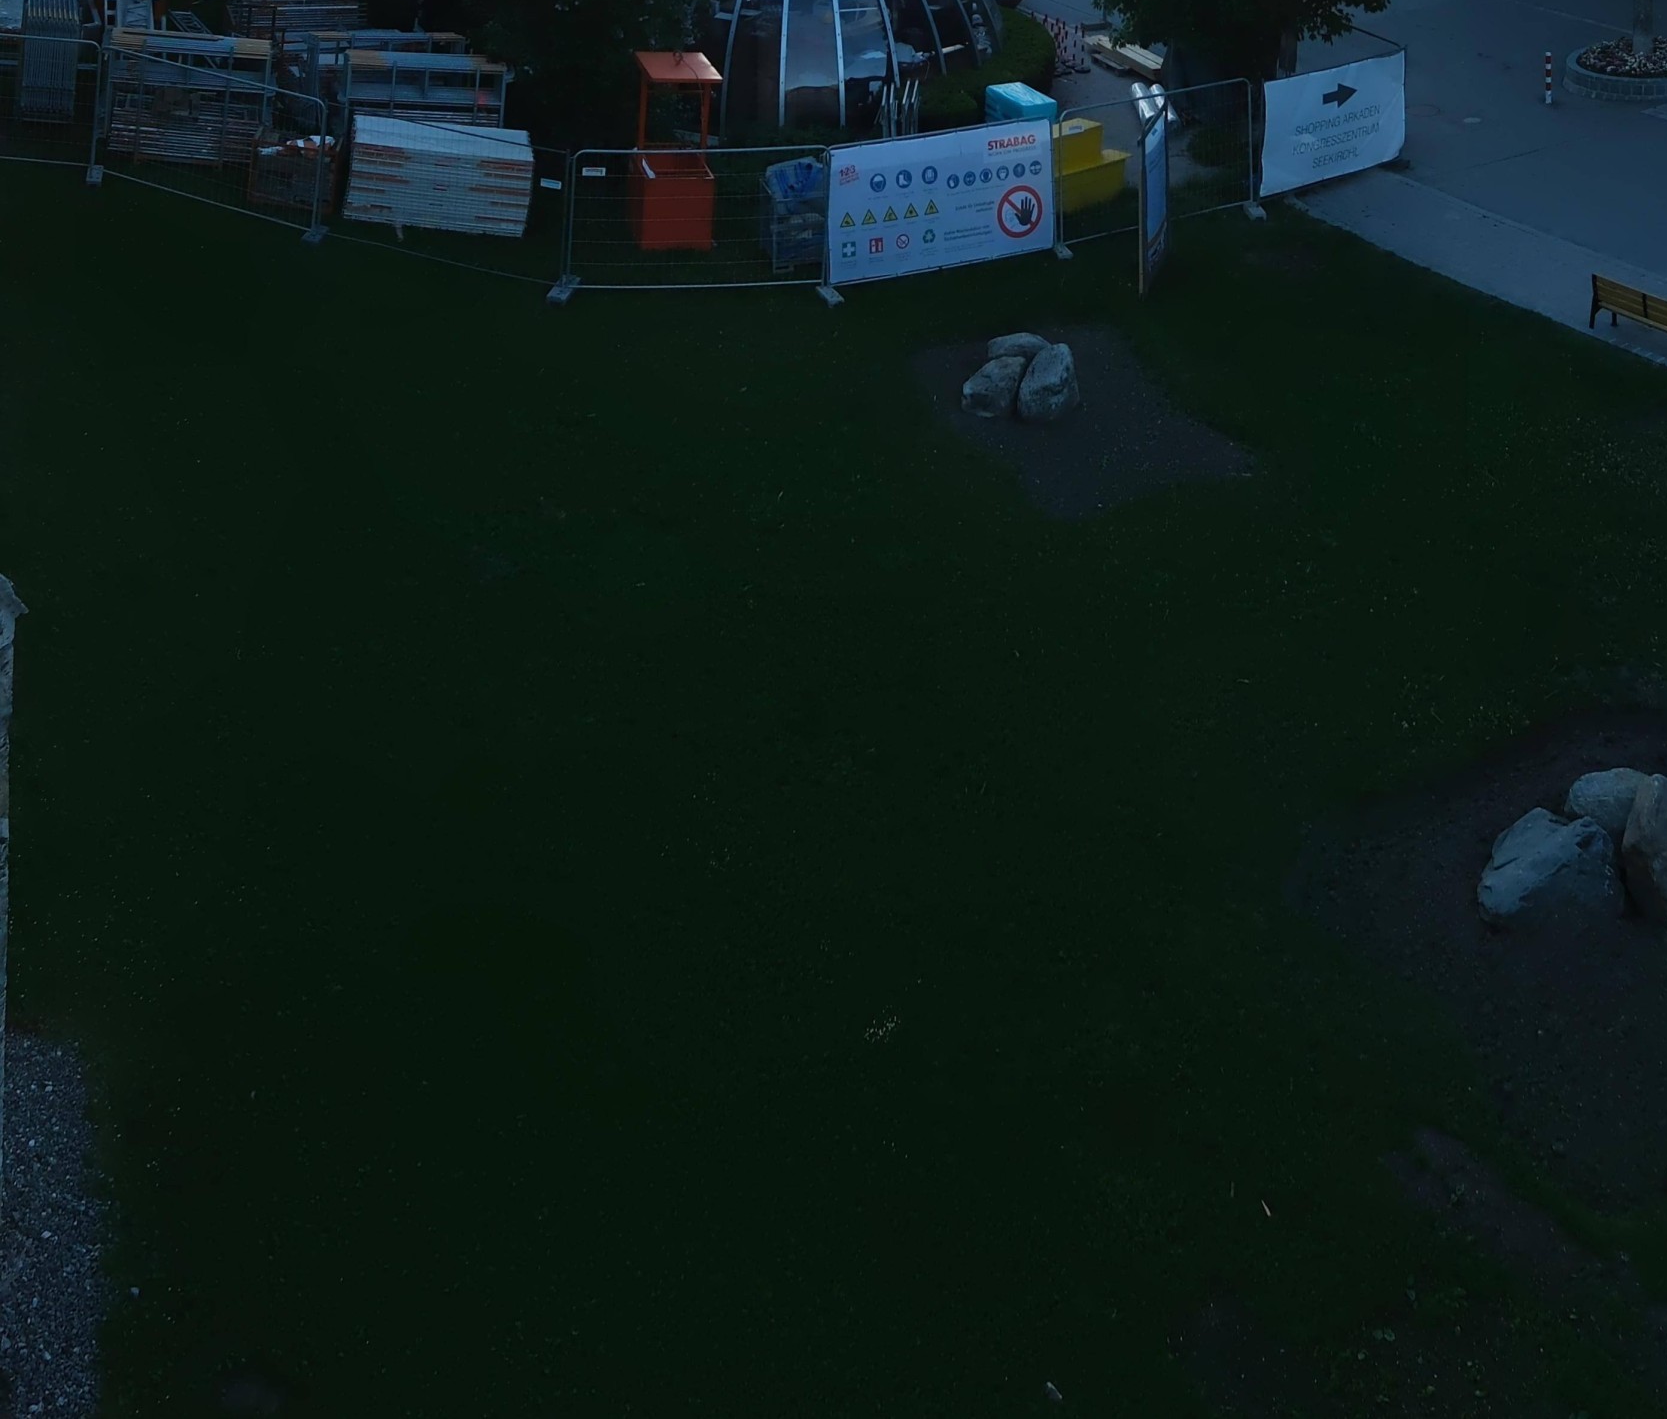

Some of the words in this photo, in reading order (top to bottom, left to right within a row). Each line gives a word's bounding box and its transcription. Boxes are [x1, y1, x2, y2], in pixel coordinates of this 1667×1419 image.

[1295, 116, 1341, 137] SHOPPING
[1343, 104, 1380, 124] ARKADEN
[987, 134, 1037, 151] STRABAG
[1292, 122, 1380, 156] KONGRESSZENTRUM
[1312, 147, 1359, 169] SEEKIRCHL
